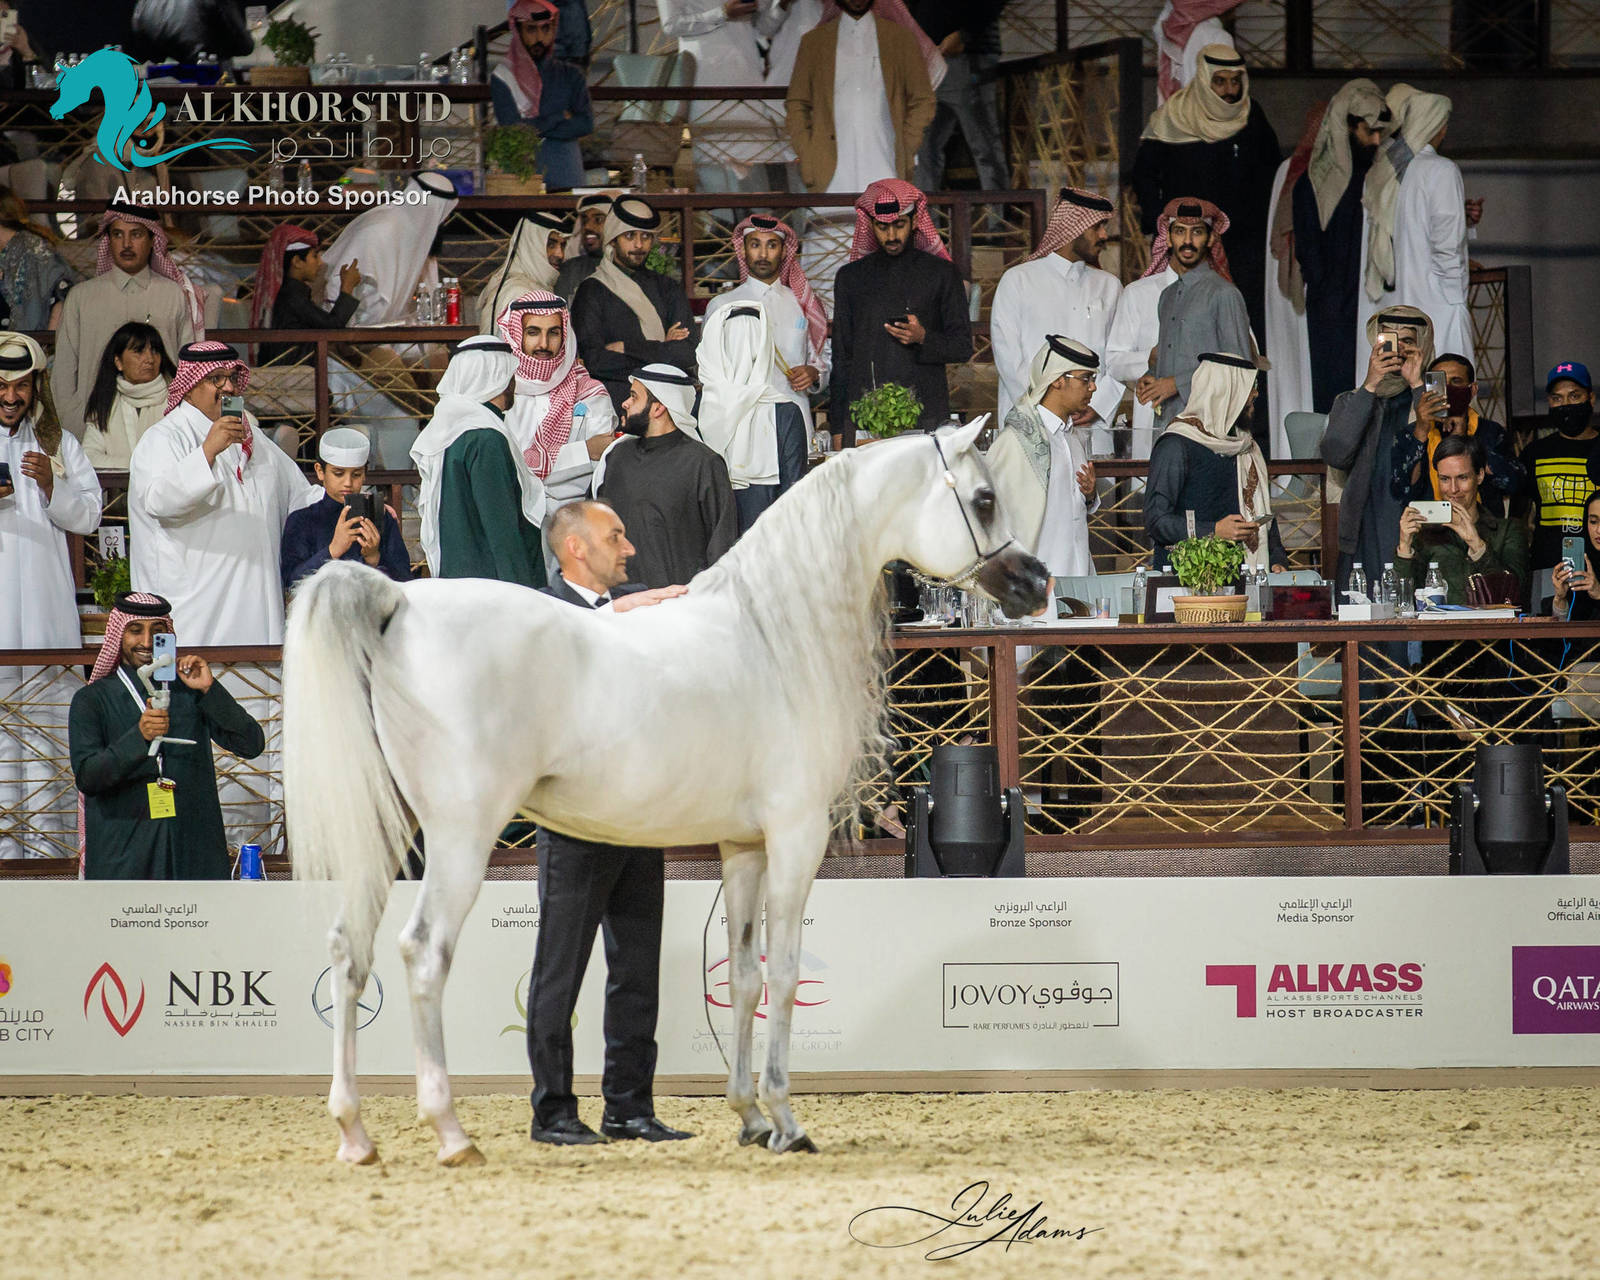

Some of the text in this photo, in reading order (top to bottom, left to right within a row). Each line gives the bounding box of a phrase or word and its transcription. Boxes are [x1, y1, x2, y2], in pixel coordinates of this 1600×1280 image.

[104, 535, 119, 547] C2
[122, 903, 197, 916] الراعي الماسي
[503, 903, 539, 916] لماسي
[994, 900, 1067, 914] الراعي البرونزي
[1320, 898, 1352, 911] الراعي
[1277, 912, 1354, 924] Media Sponsor
[1547, 911, 1585, 921] Official
[110, 918, 209, 930] Diamond Sponsor
[989, 917, 1072, 929] Bronze Sponsor
[1267, 963, 1423, 992] ALKASS
[166, 970, 276, 1007] NBK
[950, 984, 1033, 1010] JOVOY
[1556, 1001, 1600, 1011] AIRWAYS
[1266, 1008, 1423, 1018] HOST BROADCASTER
[164, 1020, 277, 1028] NASSER BIN KHALED
[993, 1022, 1030, 1030] PERFUMES
[16, 1028, 54, 1041] CITY
[801, 1039, 843, 1051] GROUP
